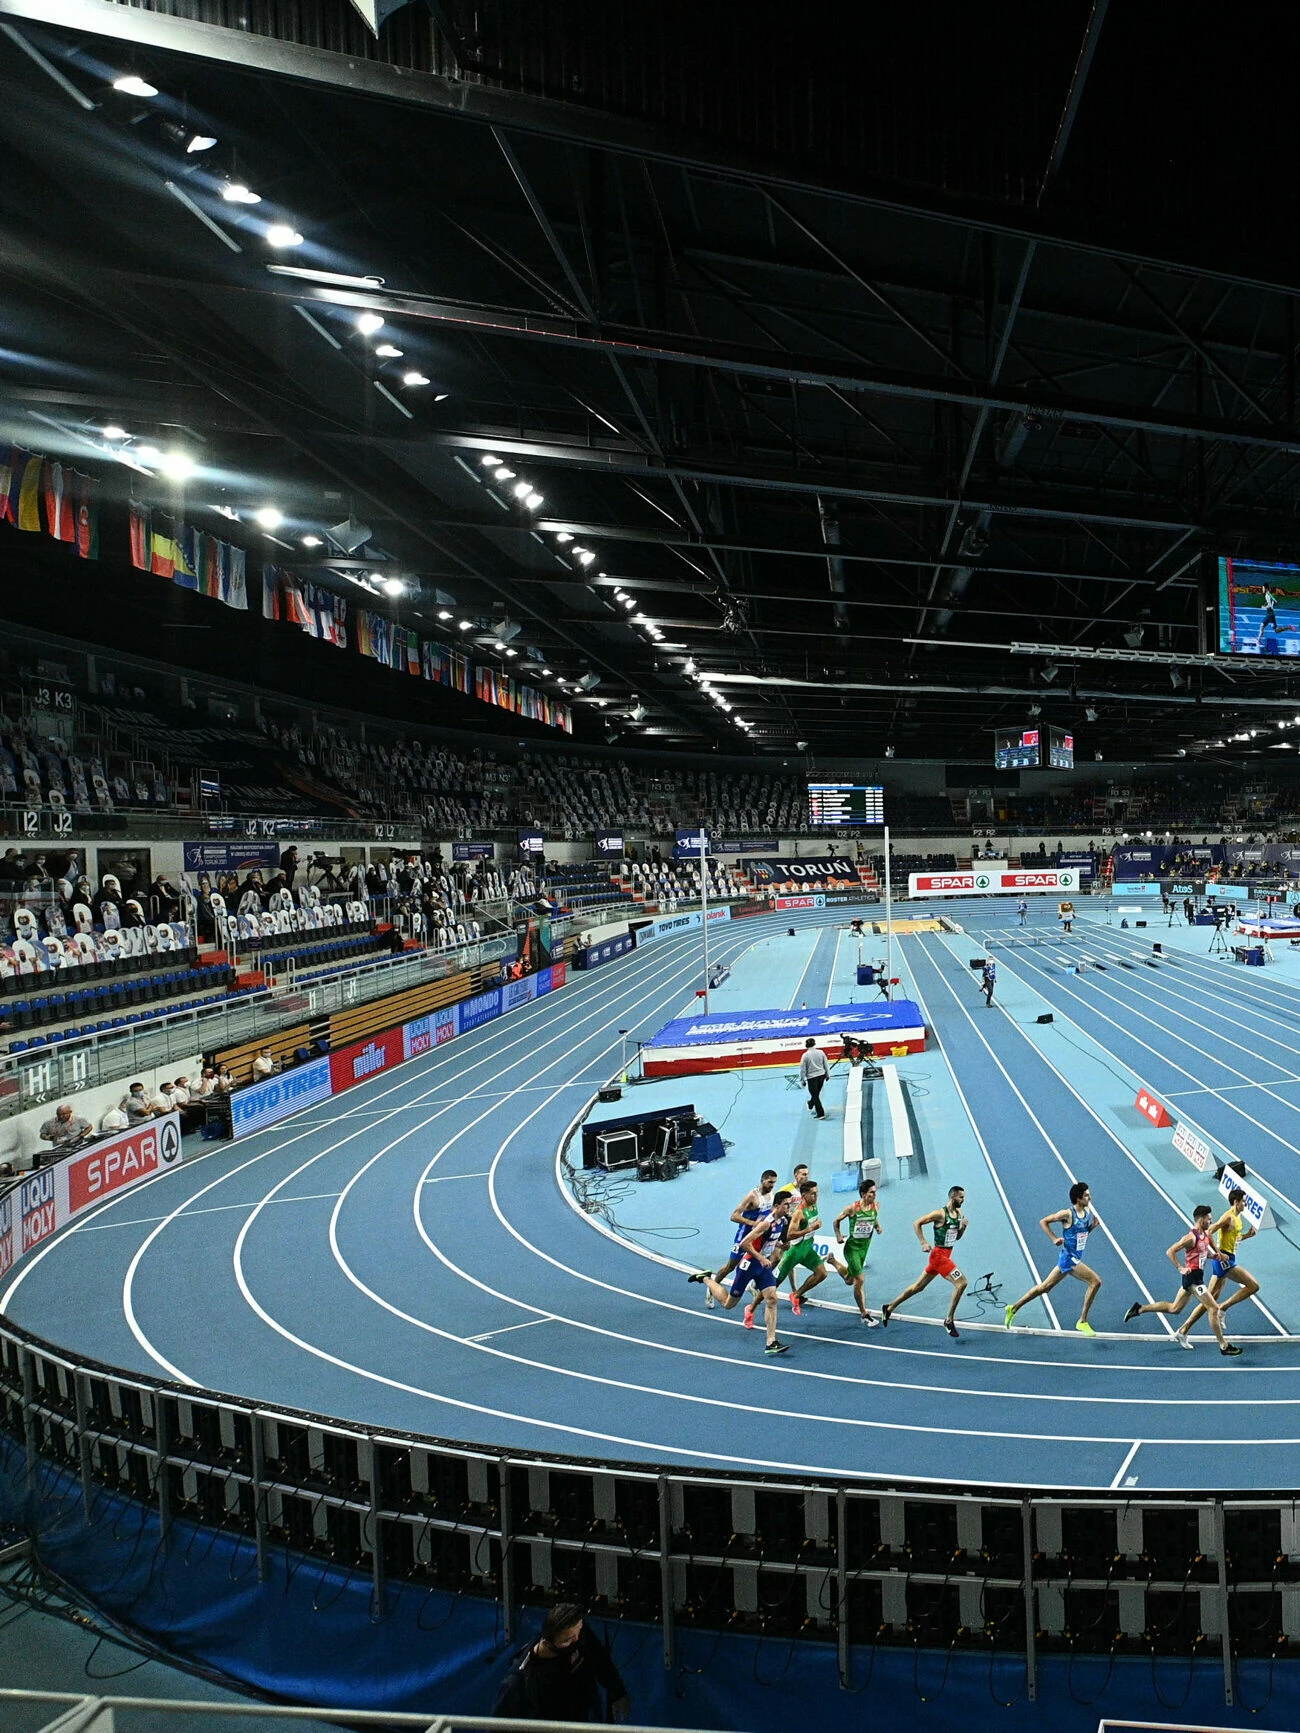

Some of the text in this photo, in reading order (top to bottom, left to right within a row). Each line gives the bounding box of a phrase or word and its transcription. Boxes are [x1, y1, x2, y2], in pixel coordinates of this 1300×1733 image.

[35, 687, 72, 709] J3 K3
[23, 811, 38, 833] I2
[54, 812, 73, 833] J2
[246, 820, 257, 835] J2
[262, 820, 275, 836] K2
[837, 830, 861, 838] O2 P2
[776, 859, 851, 877] TORUŃ
[930, 877, 973, 889] SPAR
[1014, 875, 1058, 886] SPAR
[784, 898, 815, 908] SPAR
[658, 917, 690, 932] TOYO TIRES
[705, 909, 726, 920] olanik
[470, 989, 499, 1016] MONDO
[436, 1007, 454, 1026] LIQUI
[410, 1017, 430, 1038] LIQUI
[437, 1022, 454, 1043] MOLY
[411, 1033, 431, 1055] MOLY
[28, 1062, 50, 1096] H1
[231, 1063, 330, 1124] TOYO TIRES
[87, 1135, 156, 1194] SPAR
[22, 1168, 55, 1215] LIQUI
[1245, 1194, 1264, 1220] IRES
[23, 1201, 55, 1249] MOLY
[952, 1269, 961, 1279] 10
